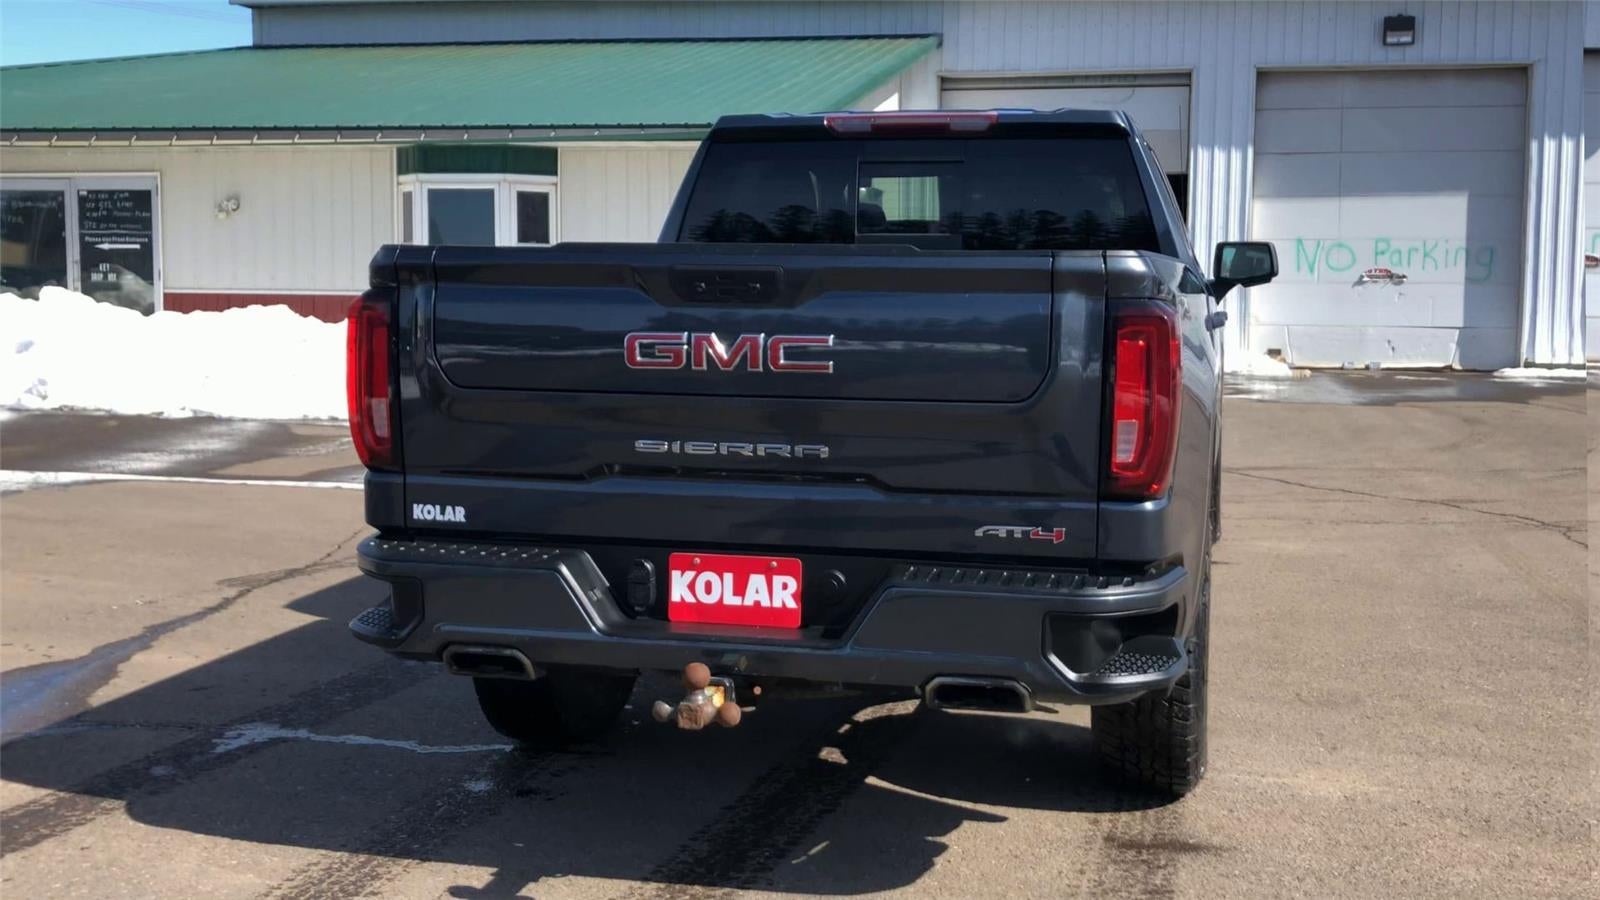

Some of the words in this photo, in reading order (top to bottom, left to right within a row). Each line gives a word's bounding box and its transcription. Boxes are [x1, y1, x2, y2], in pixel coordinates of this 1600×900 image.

[624, 331, 835, 374] GMC
[634, 439, 830, 459] SIERRA
[412, 503, 466, 522] KOLAR
[974, 525, 1065, 544] AT4
[671, 570, 798, 608] KOLAR
